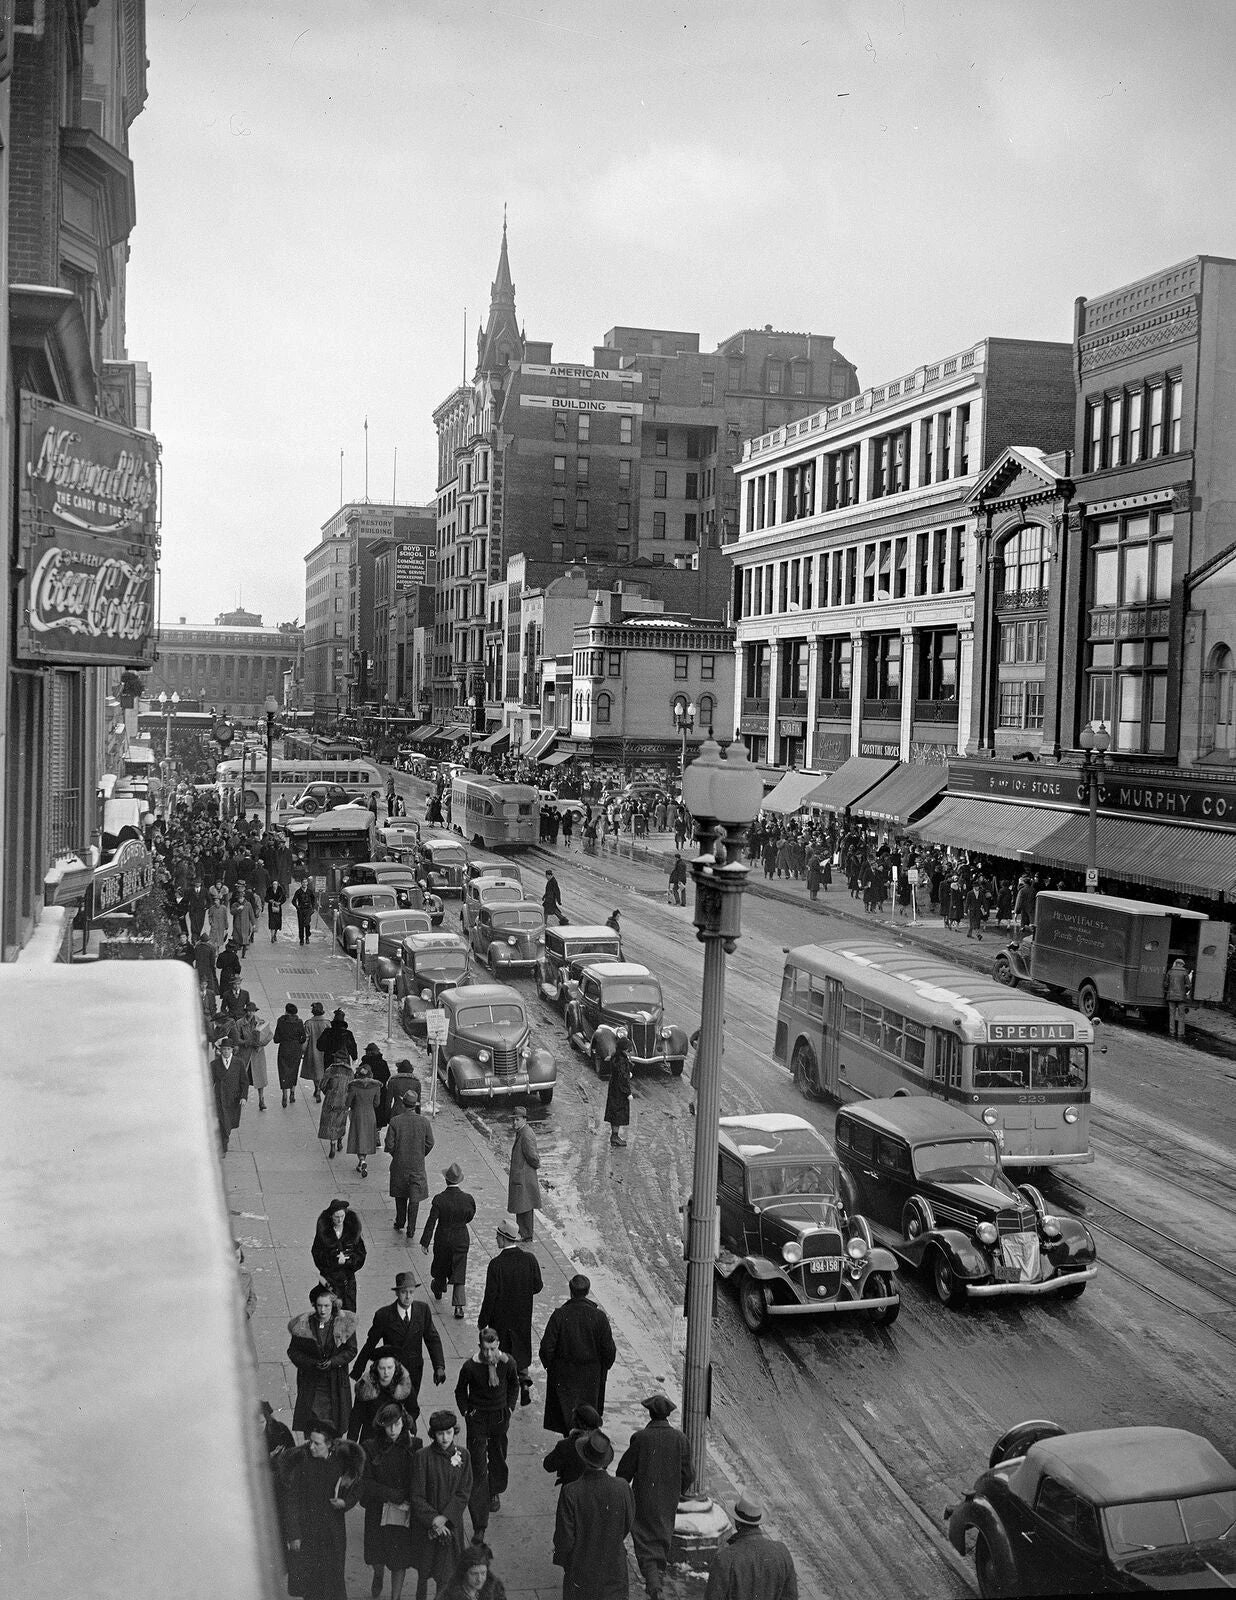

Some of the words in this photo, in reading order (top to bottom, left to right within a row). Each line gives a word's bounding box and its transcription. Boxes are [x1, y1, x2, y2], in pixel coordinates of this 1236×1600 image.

[549, 367, 609, 379] AMERICAN
[552, 399, 607, 411] BUILDING
[57, 491, 71, 506] THE
[73, 495, 96, 512] CANDY
[97, 502, 107, 515] OF
[884, 745, 900, 757] SHOES
[989, 777, 995, 788] 5
[1031, 781, 1061, 795] STORE
[1119, 788, 1191, 813] MURPHY
[995, 1026, 1067, 1039] SPECIAL
[1018, 1095, 1047, 1104] 223
